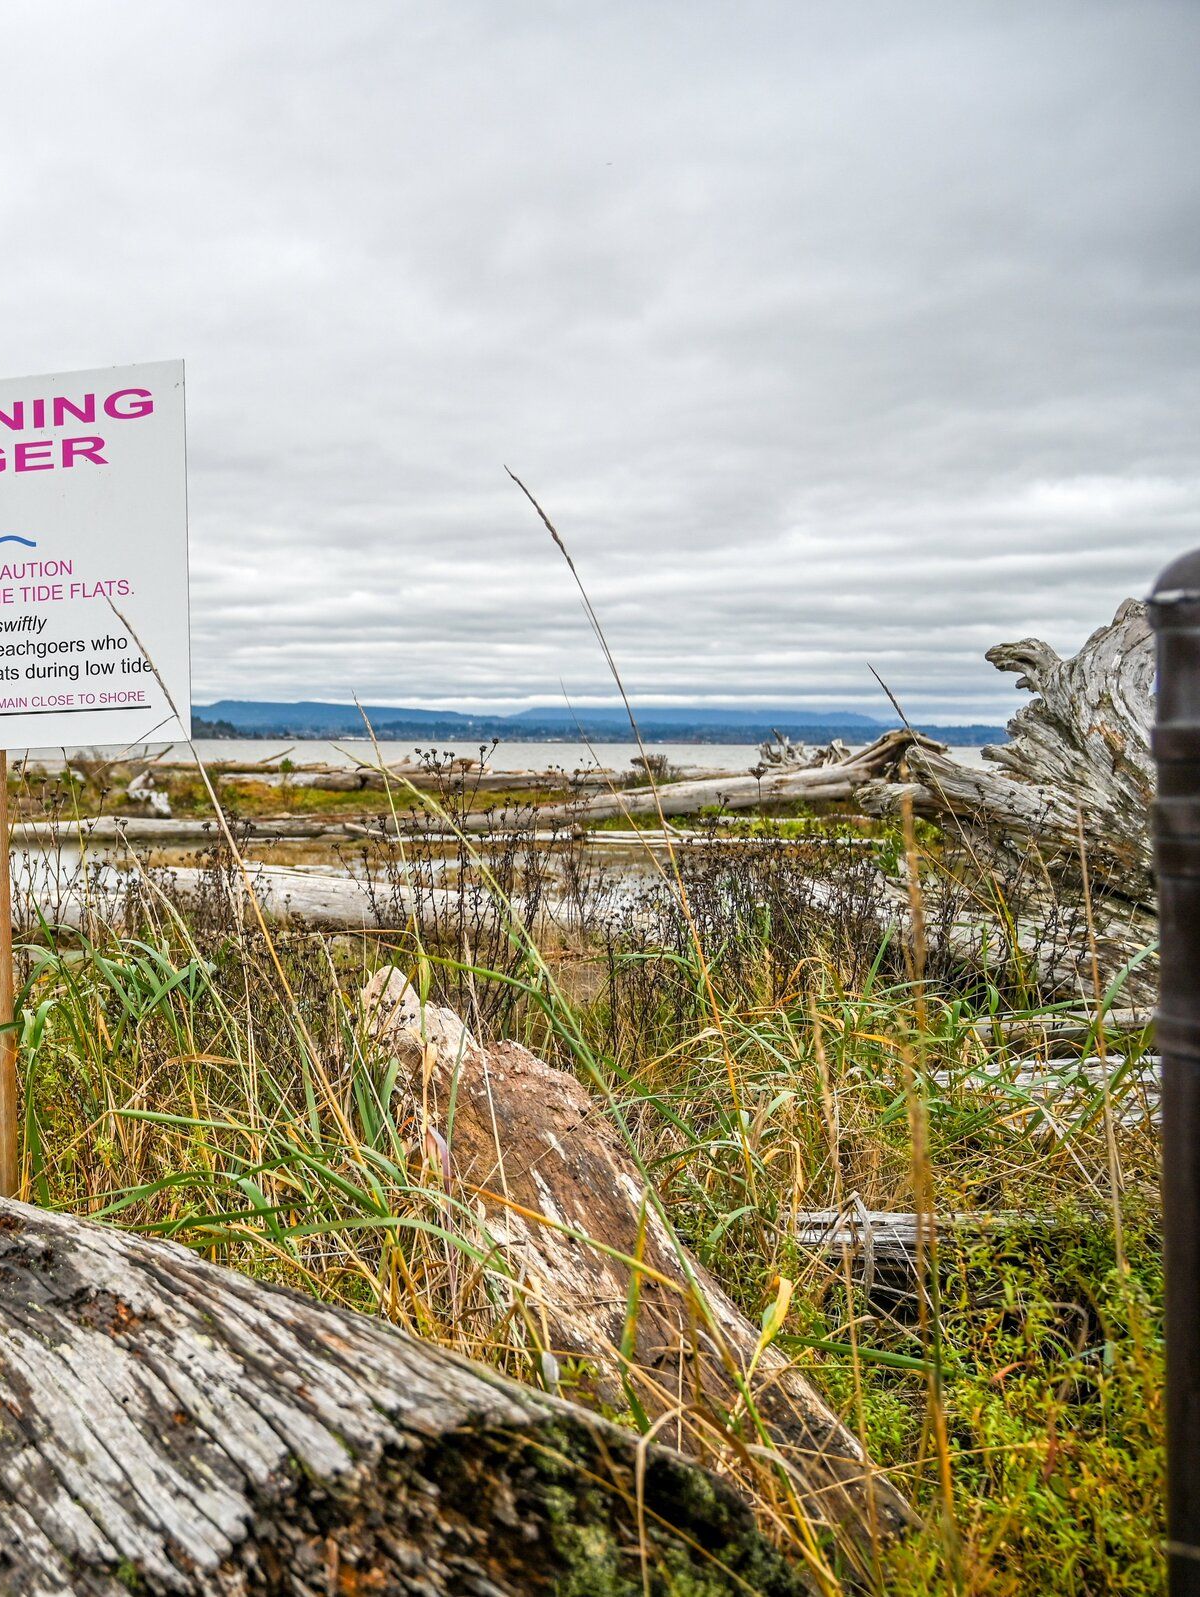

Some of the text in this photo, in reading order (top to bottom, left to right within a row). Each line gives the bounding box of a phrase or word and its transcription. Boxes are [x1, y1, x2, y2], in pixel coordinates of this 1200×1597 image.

[20, 585, 63, 602] TIDE
[70, 580, 134, 599] FLATS.
[91, 635, 128, 650] who
[25, 663, 79, 680] during
[85, 660, 114, 676] low
[32, 695, 74, 707] CLOSE
[78, 694, 96, 704] TO
[100, 691, 145, 703] SHORE
